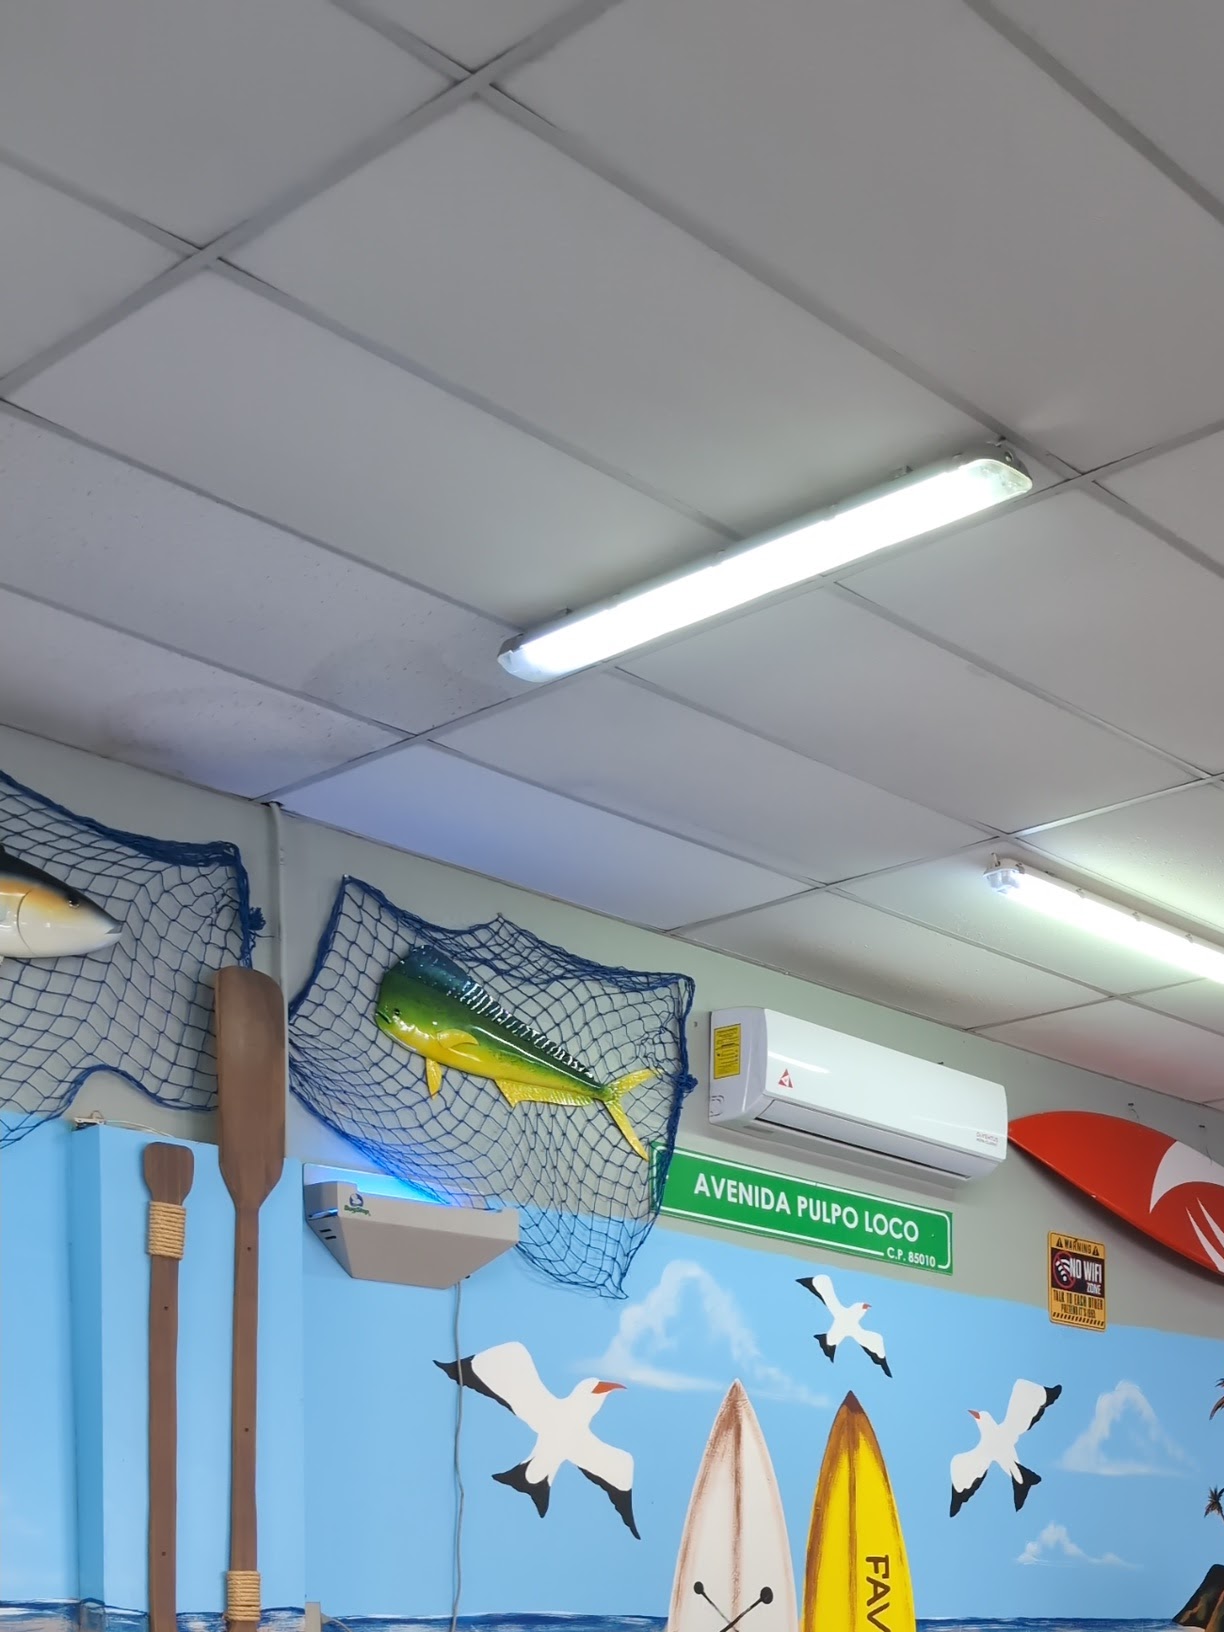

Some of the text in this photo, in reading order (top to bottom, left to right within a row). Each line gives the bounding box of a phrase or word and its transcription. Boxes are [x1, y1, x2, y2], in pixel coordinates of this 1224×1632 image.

[693, 1172, 919, 1243] AVENIDA PULPO LOCO
[886, 1246, 936, 1268] C.P. 85010
[1064, 1239, 1092, 1254] WARNING
[1069, 1257, 1102, 1284] NO WIFI
[1086, 1282, 1102, 1295] ZONE
